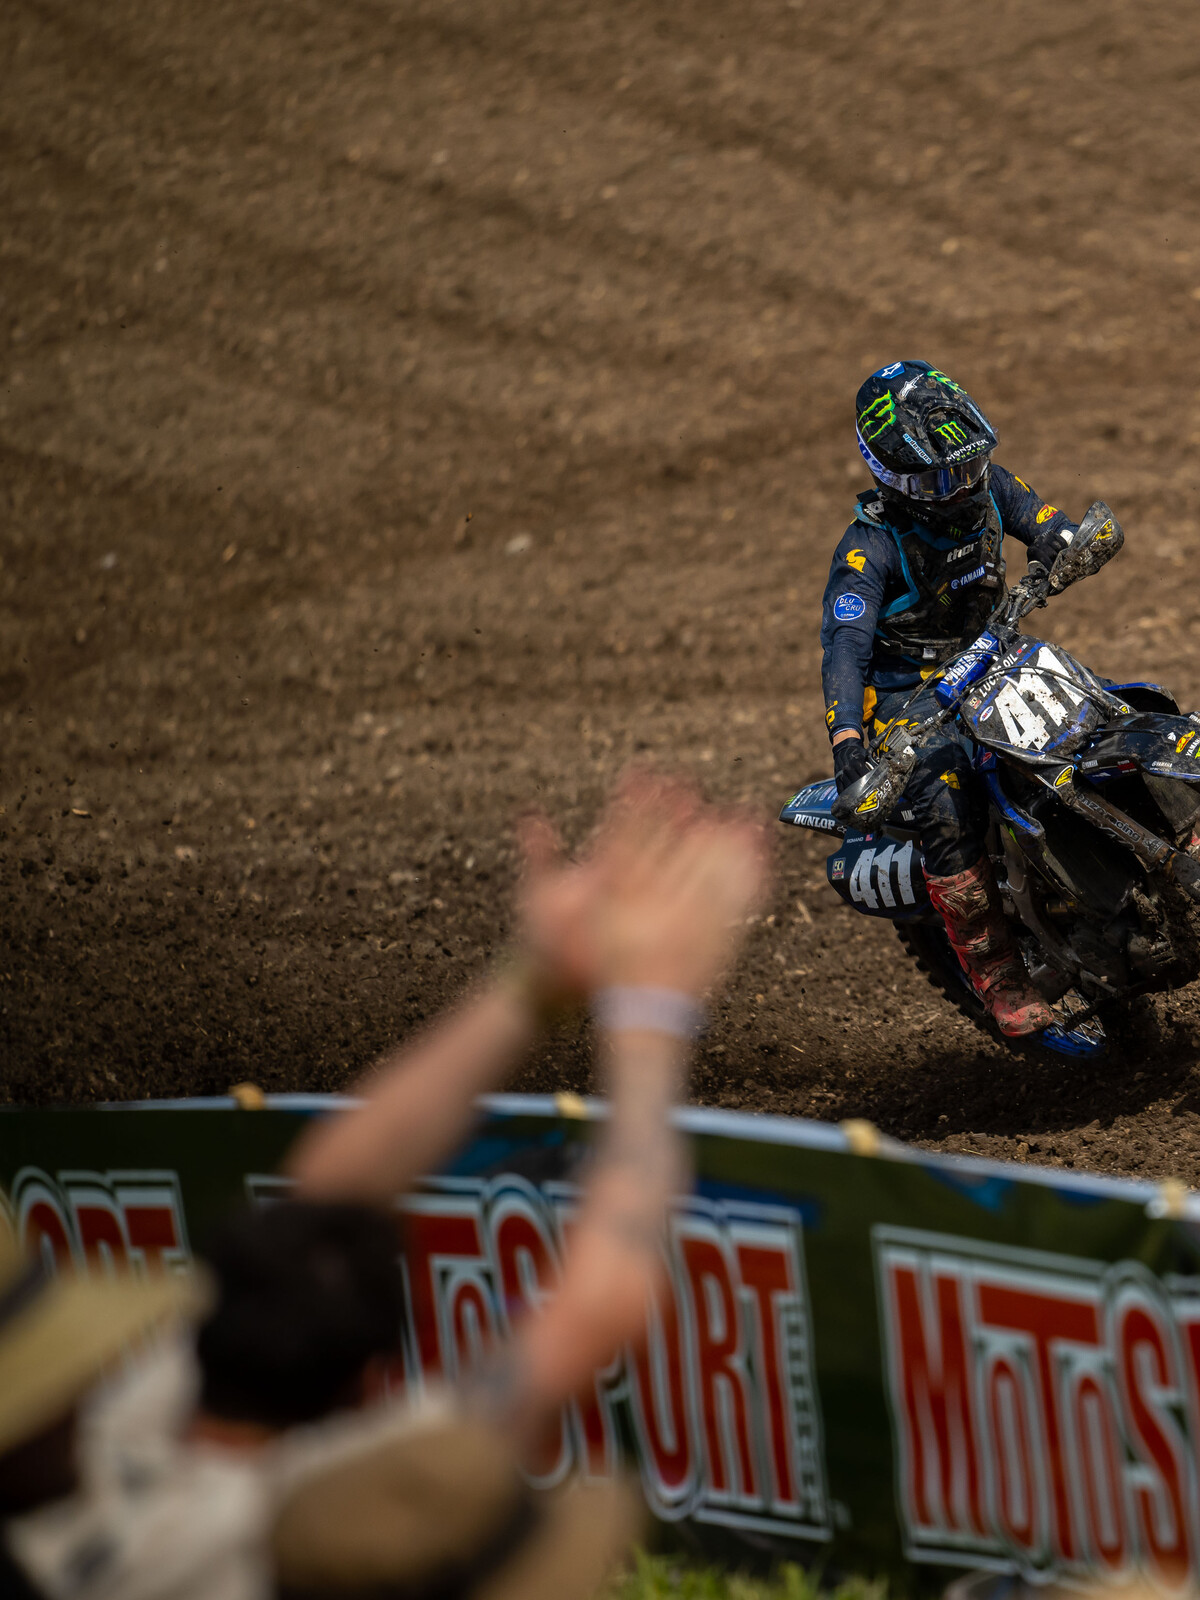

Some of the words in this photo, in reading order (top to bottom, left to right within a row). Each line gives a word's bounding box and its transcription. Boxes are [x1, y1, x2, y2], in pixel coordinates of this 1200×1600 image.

[946, 439, 989, 461] MONSTER
[979, 665, 1005, 697] LUCS
[1003, 653, 1019, 668] OIL
[793, 813, 836, 830] DUNLOP
[849, 840, 916, 909] 411
